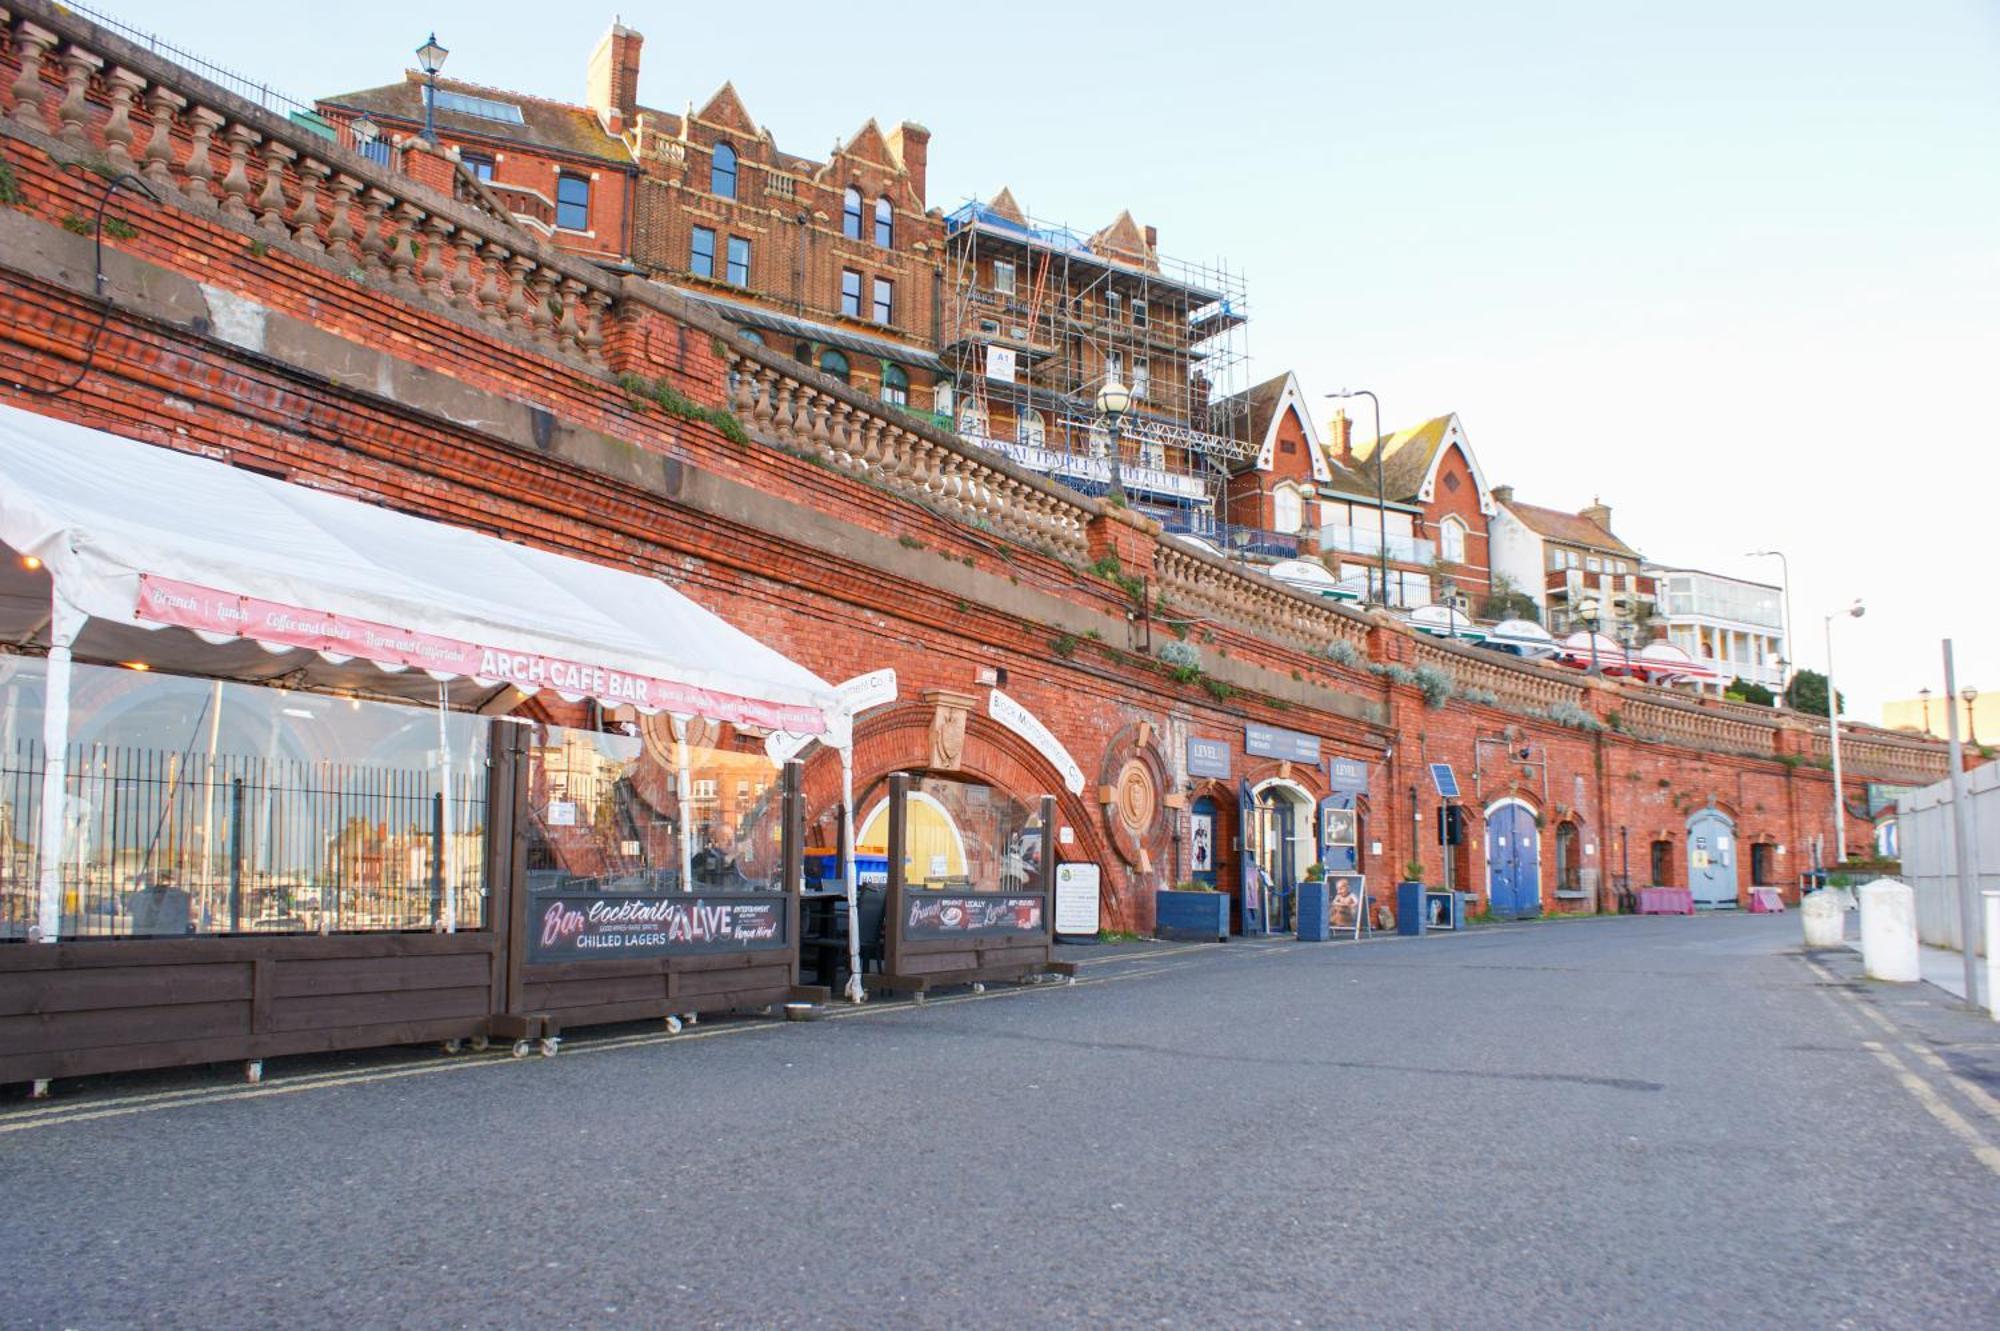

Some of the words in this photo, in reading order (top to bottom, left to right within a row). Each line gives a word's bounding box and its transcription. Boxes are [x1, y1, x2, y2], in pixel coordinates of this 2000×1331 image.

[480, 650, 545, 683] ARCH
[550, 662, 606, 693] CAFE
[609, 673, 647, 701] BAR
[1194, 743, 1218, 760] LEVEL
[586, 899, 675, 922] Cocktails
[540, 901, 585, 946] Bar
[576, 934, 621, 948] CHILLED
[625, 932, 666, 946] LAGERS
